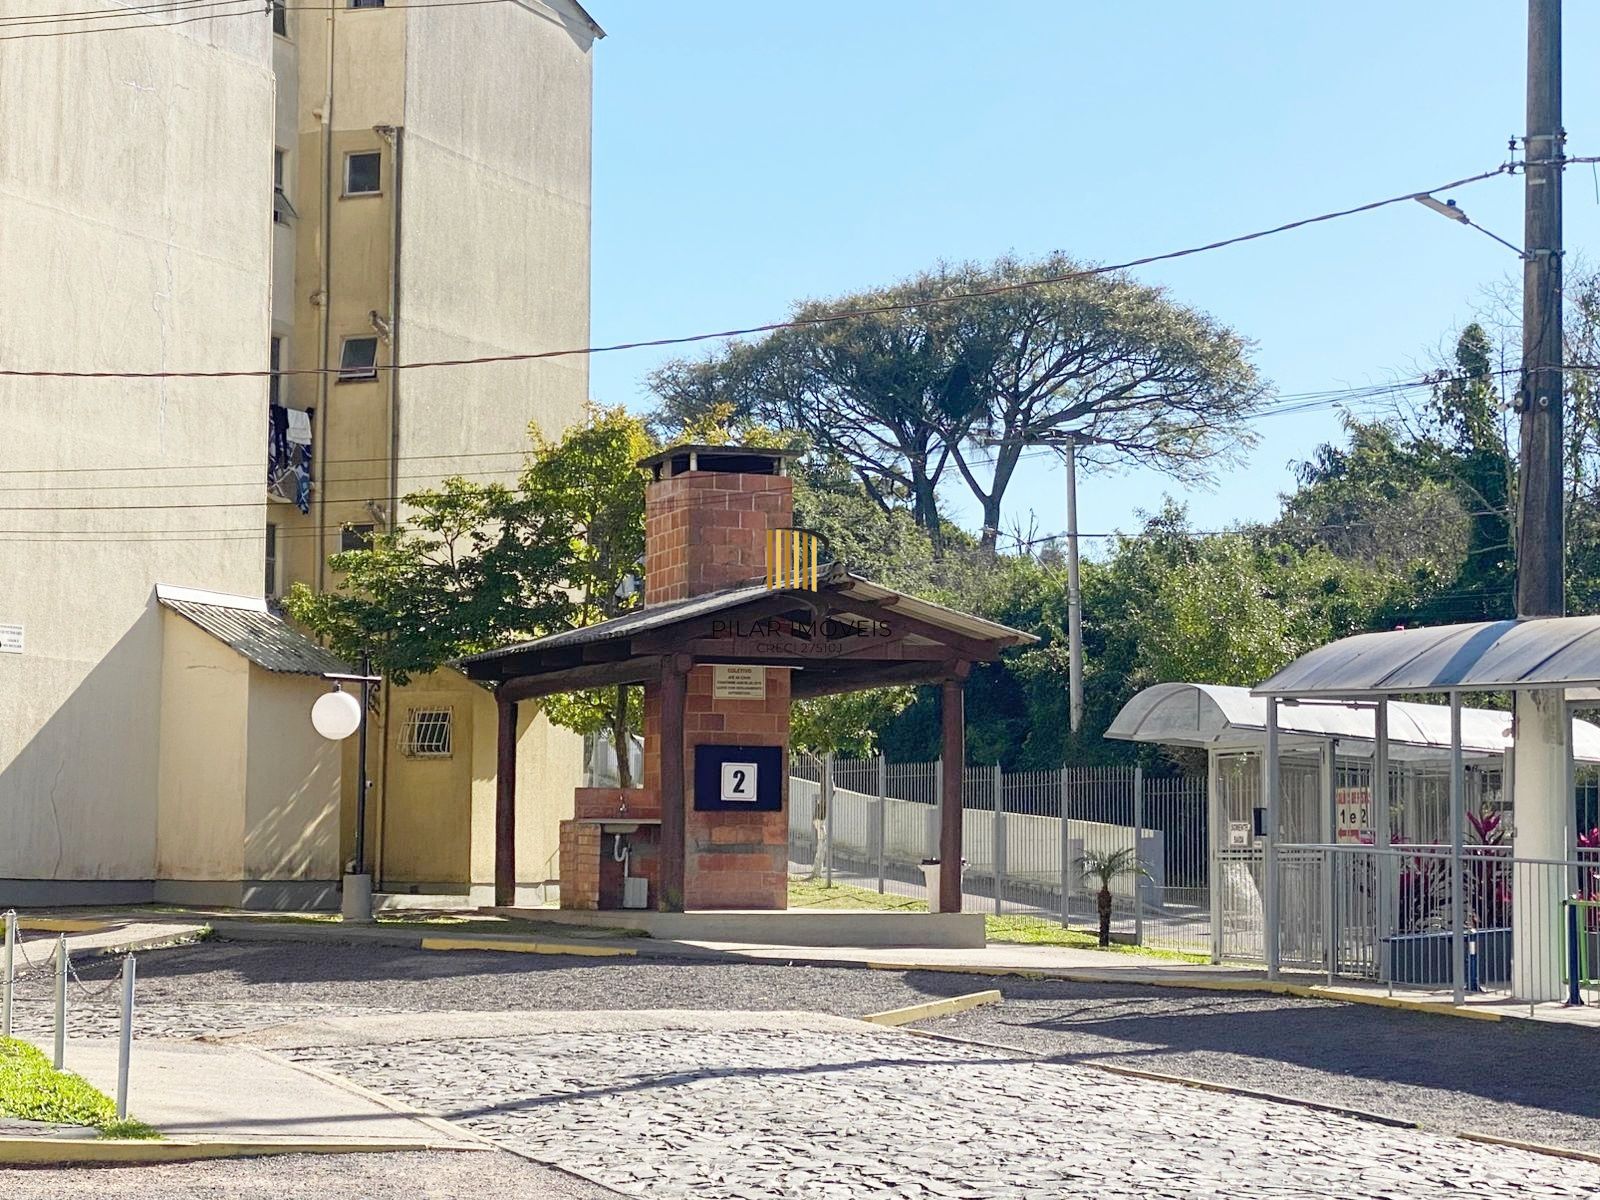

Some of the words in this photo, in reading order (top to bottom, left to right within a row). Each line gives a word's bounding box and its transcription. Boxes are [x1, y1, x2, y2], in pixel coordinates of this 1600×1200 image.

[733, 770, 745, 793] 2
[1340, 809, 1345, 824] 1
[1350, 812, 1356, 824] e
[1361, 808, 1367, 824] 2
